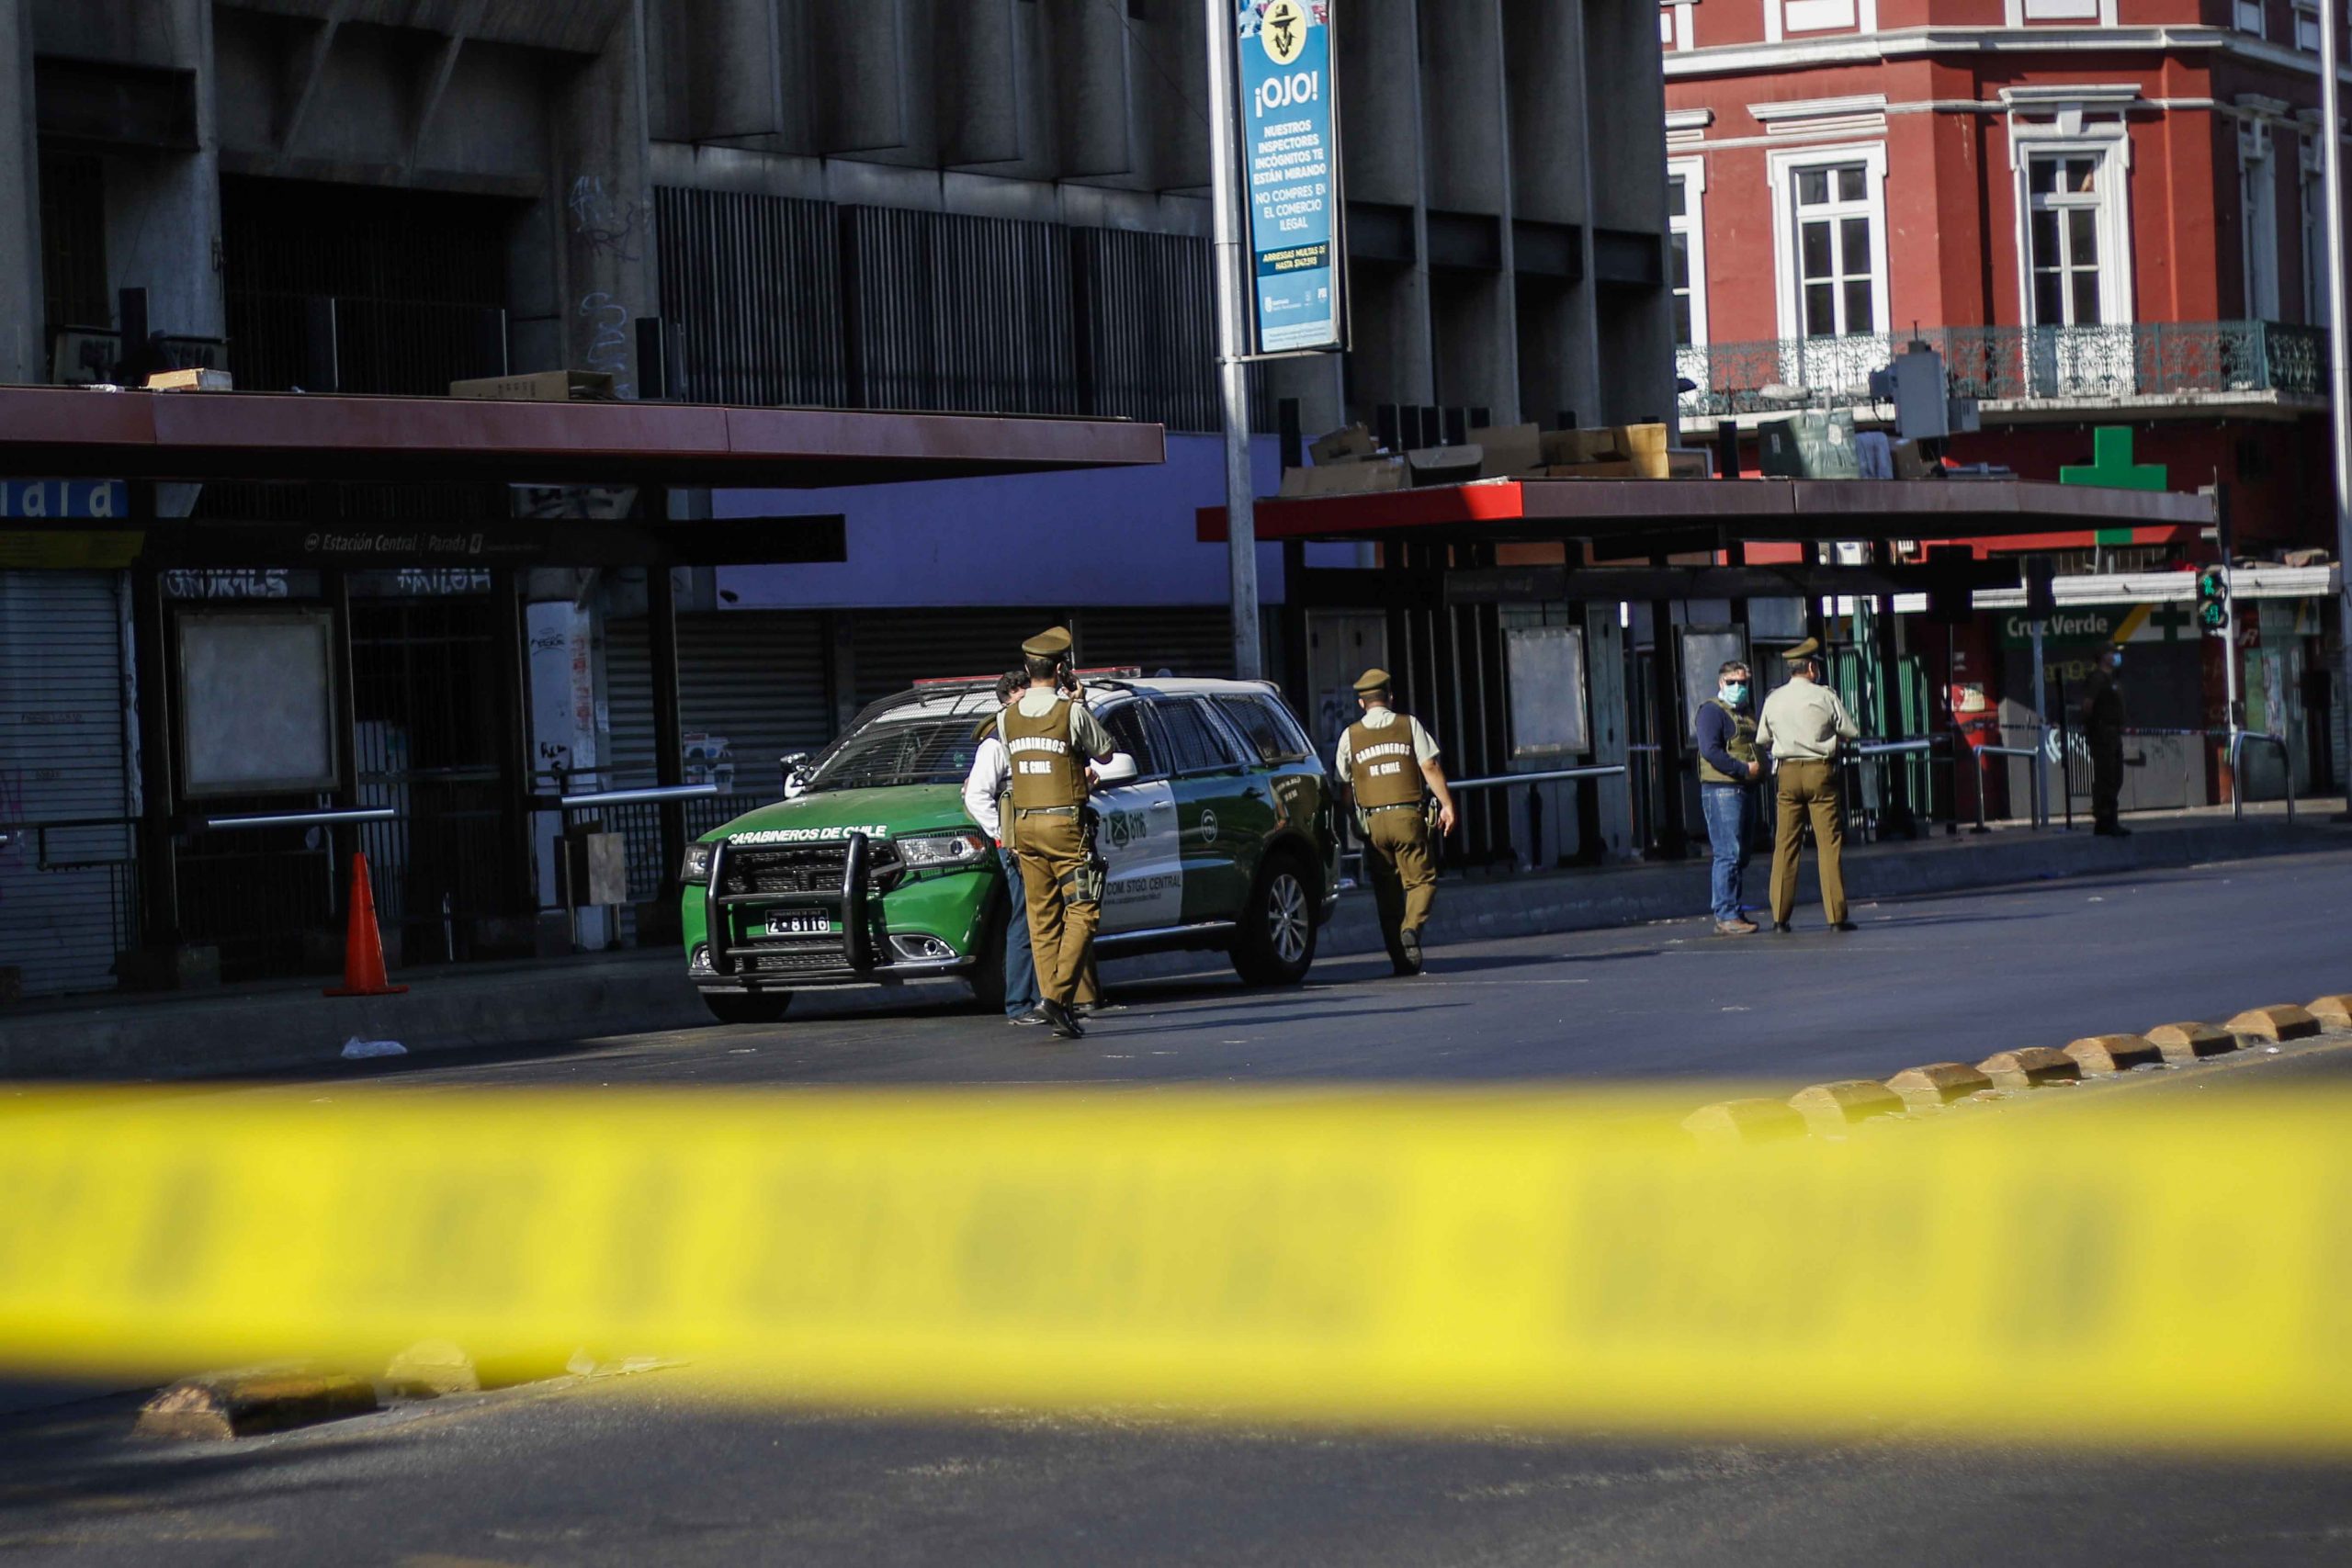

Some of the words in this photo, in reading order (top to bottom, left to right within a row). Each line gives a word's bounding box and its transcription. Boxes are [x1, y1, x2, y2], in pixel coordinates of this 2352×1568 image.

[1255, 71, 1317, 118] ¡OJO!
[1264, 120, 1312, 138] NUESTROS
[1258, 134, 1319, 153] INSPECTORES
[1255, 150, 1312, 169] INCÓGNITOS
[1314, 148, 1325, 161] TE
[1253, 169, 1283, 186] ESTÁN
[1285, 164, 1327, 181] MIRANDO
[1255, 191, 1271, 205] NO
[1272, 185, 1314, 202] COMPRES
[1263, 207, 1275, 219] EL
[1276, 198, 1322, 217] COMERCIO
[1280, 217, 1308, 231] ILEGAL
[322, 532, 372, 551] Estación
[375, 533, 417, 551] Central
[428, 533, 467, 551] Parada
[2052, 612, 2109, 636] Verde
[1009, 737, 1067, 755] CARABINEROS
[1355, 743, 1410, 764] CARABINEROS
[1019, 761, 1029, 774] DE
[1030, 761, 1052, 773] CHILE
[1370, 765, 1379, 776] DE
[1381, 761, 1401, 775] CHILE
[729, 828, 820, 844] CARABINEROS
[820, 827, 841, 839] DE
[842, 825, 888, 838] CHILE
[1102, 818, 1111, 844] Z
[1129, 813, 1147, 840] 8116
[1148, 874, 1182, 890] CENTRAL
